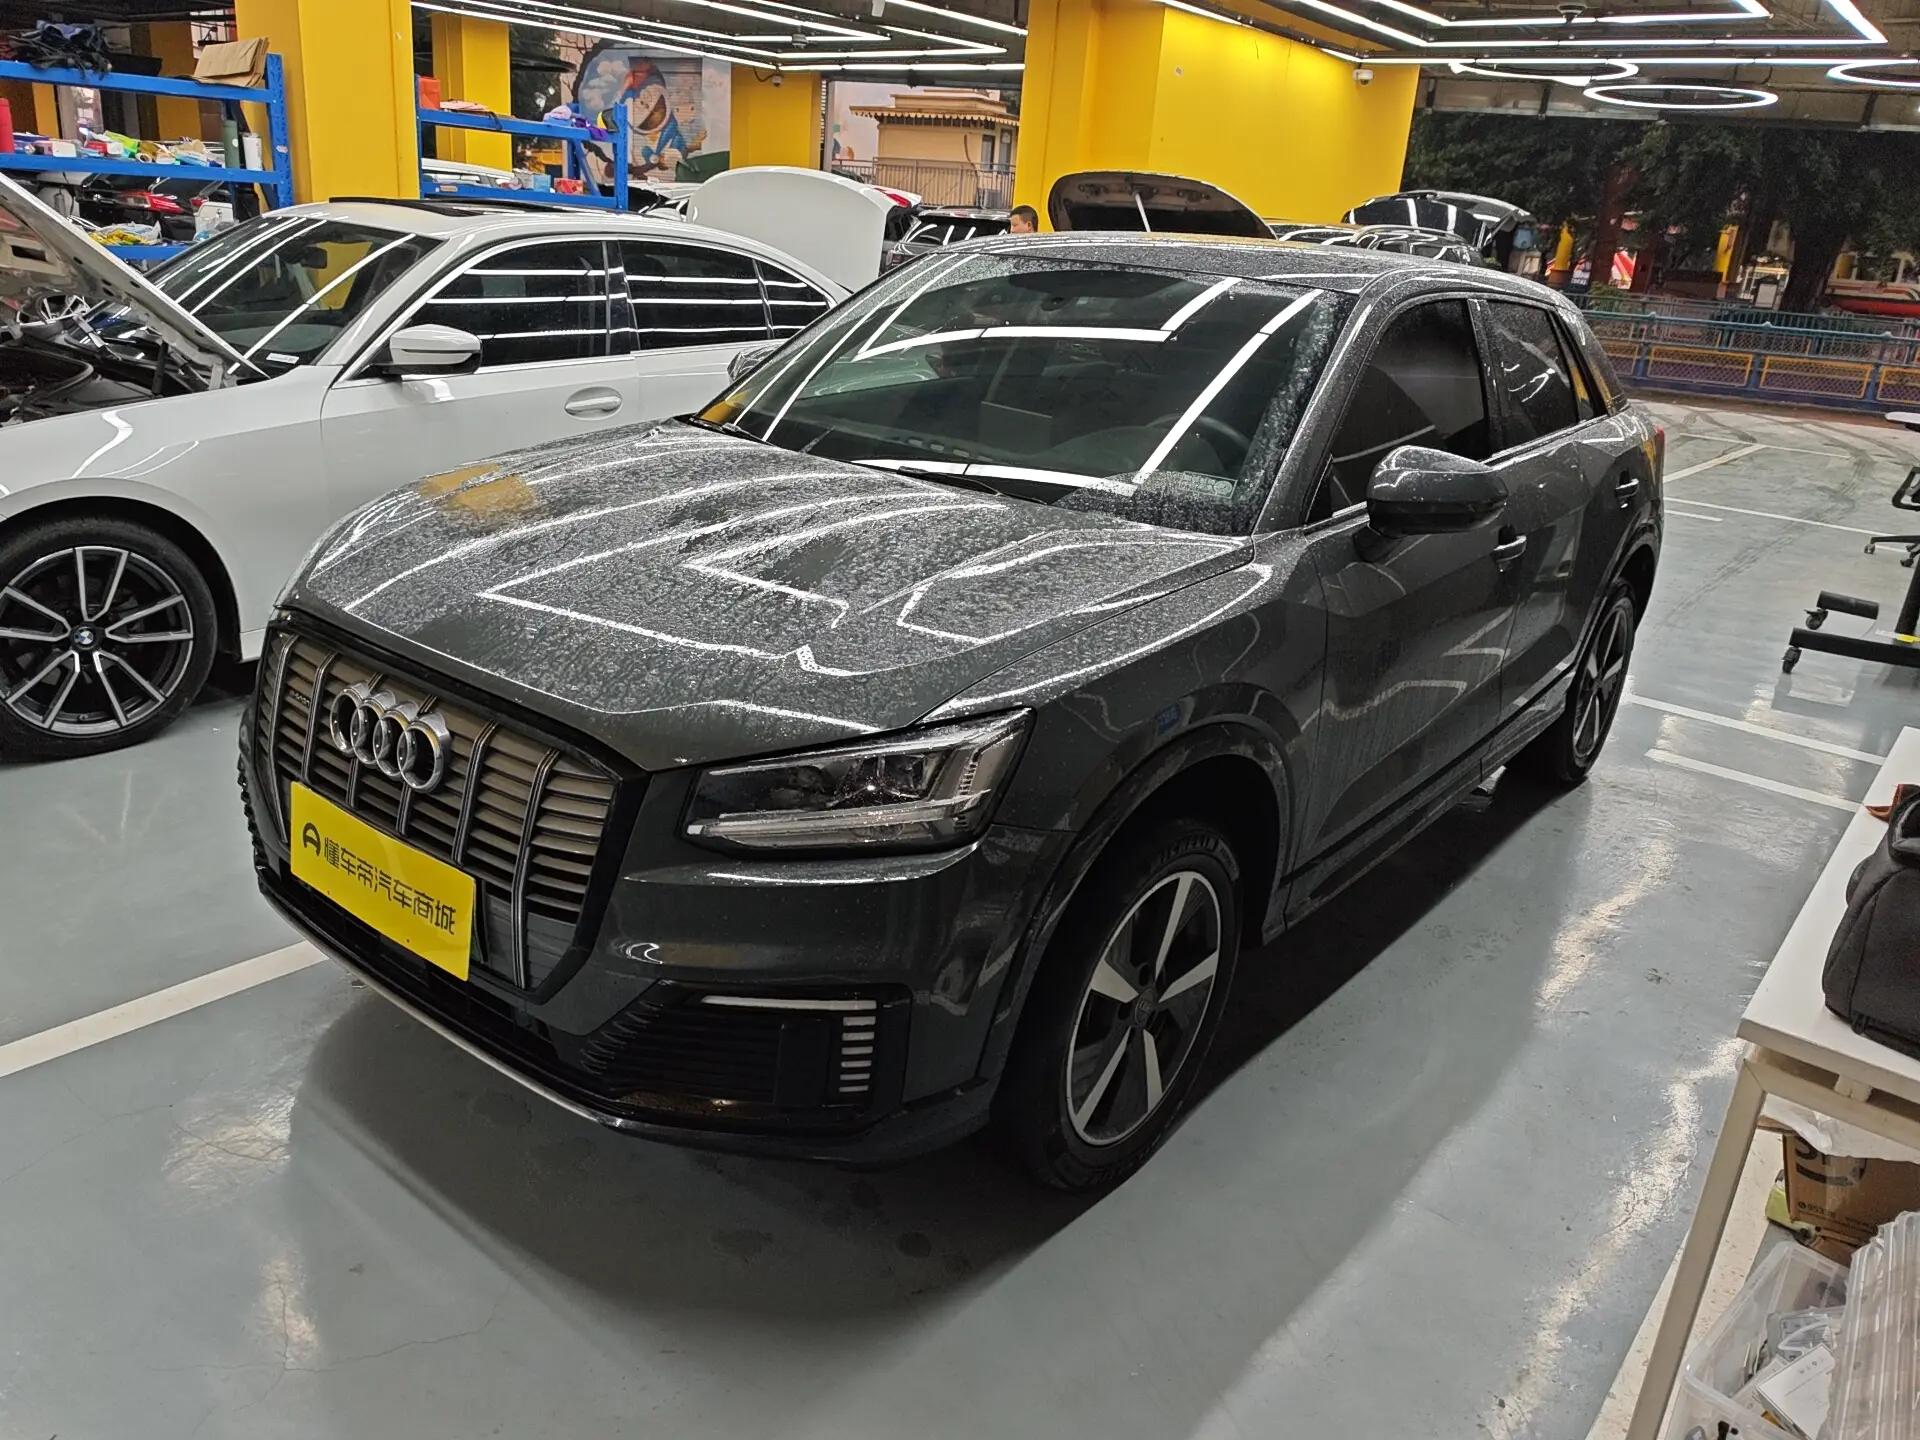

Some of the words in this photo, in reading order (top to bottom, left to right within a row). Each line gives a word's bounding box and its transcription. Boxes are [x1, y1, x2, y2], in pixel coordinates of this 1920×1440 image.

[324, 837, 456, 935] 懂车帝汽车商城
